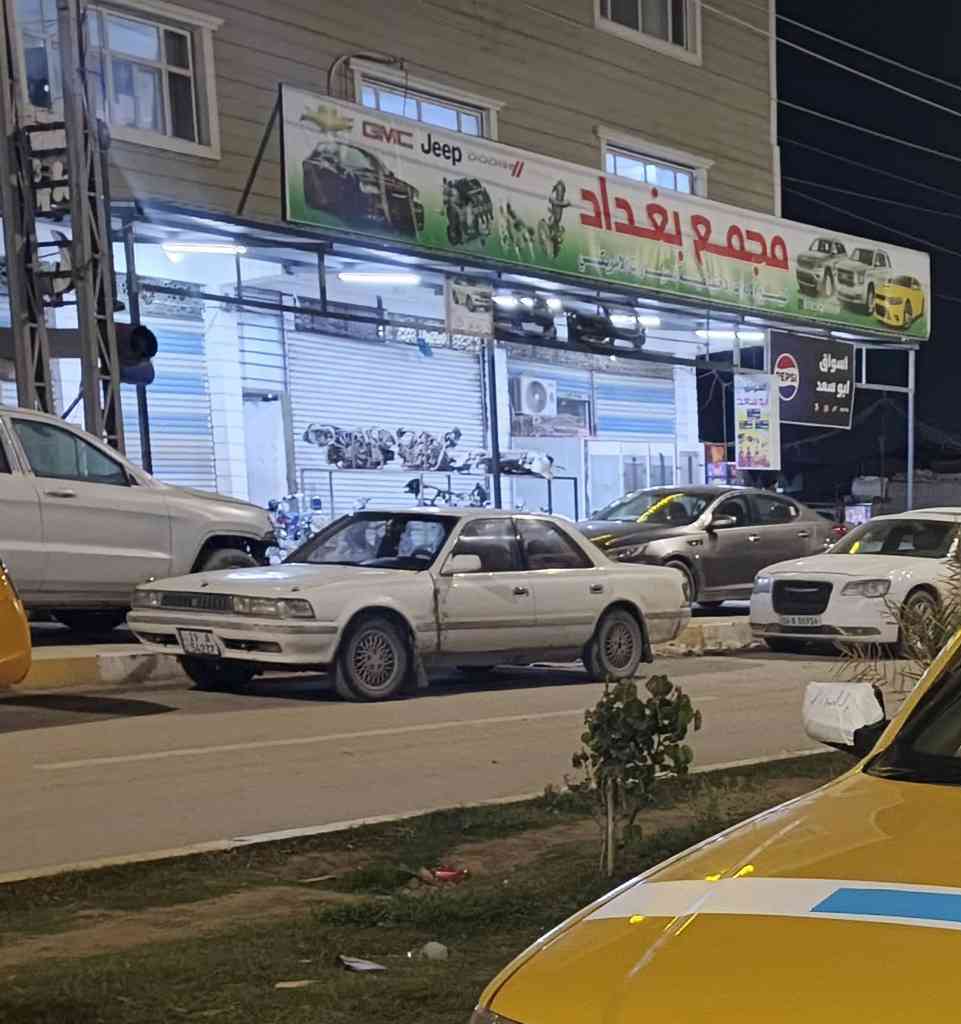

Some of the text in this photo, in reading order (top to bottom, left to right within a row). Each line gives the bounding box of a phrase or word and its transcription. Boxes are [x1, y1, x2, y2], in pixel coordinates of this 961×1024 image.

[362, 121, 414, 149] GMC
[421, 133, 462, 165] Jeep
[580, 176, 789, 276] مجمع بغداد
[819, 353, 848, 373] اسواق
[816, 380, 850, 398] ابو سعد
